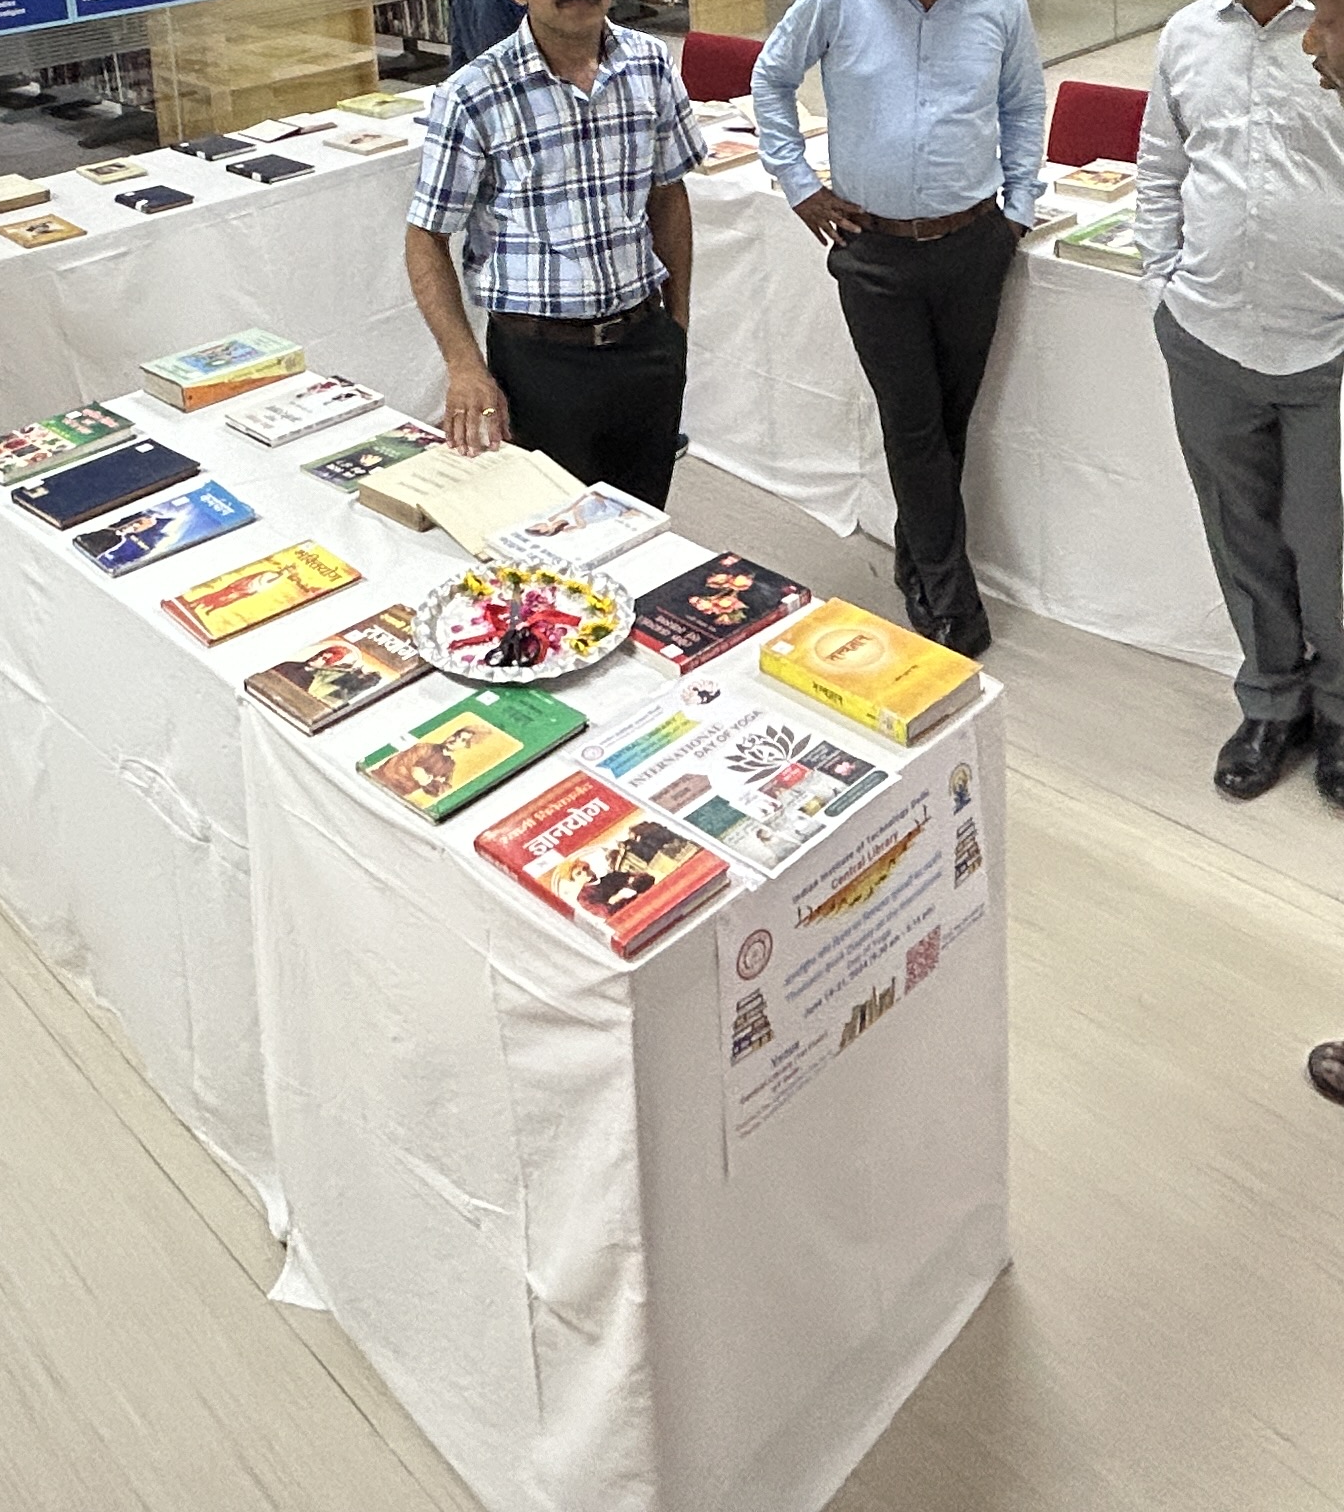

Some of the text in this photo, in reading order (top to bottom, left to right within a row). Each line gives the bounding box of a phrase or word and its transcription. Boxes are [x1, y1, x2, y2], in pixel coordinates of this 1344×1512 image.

[628, 724, 724, 787] INTERNATIONAL
[689, 710, 764, 758] DAY OF YOGA
[522, 796, 610, 858] ज्ञानयोग
[830, 830, 899, 890] Central Library
